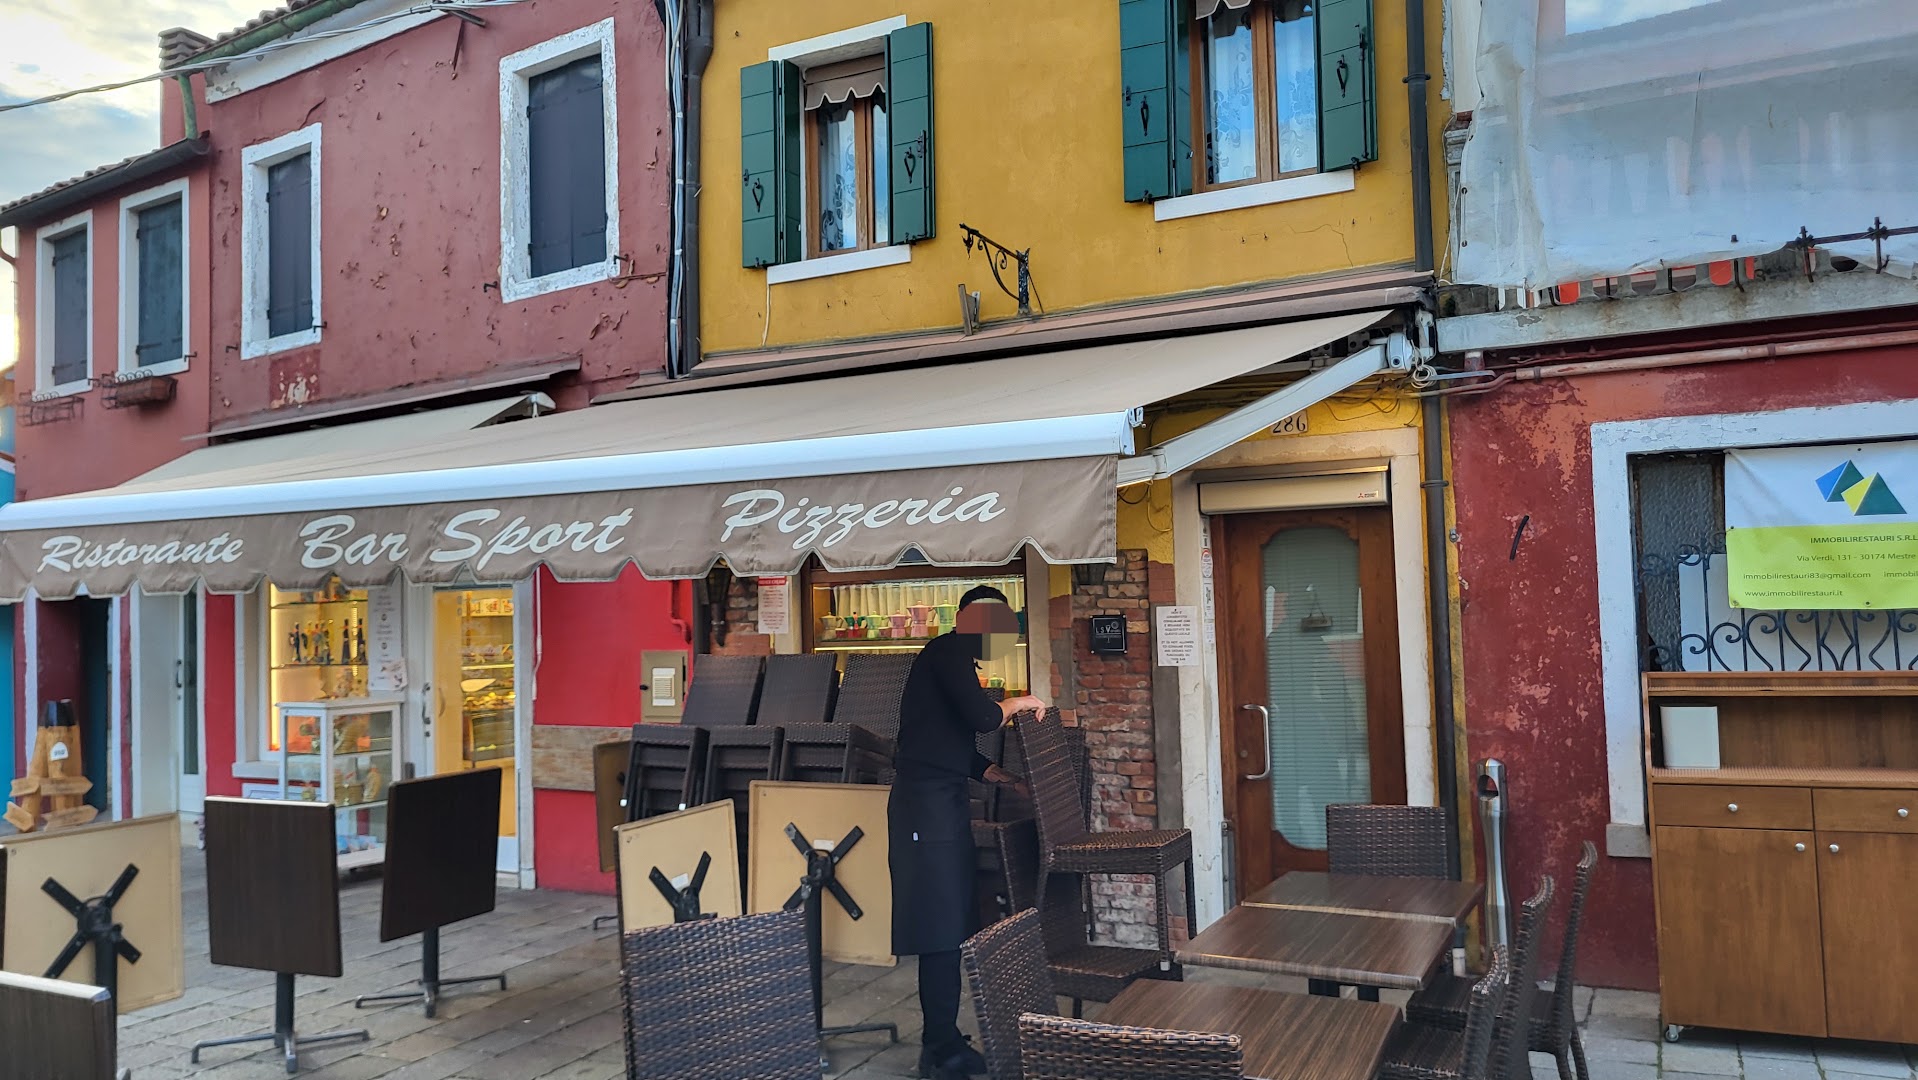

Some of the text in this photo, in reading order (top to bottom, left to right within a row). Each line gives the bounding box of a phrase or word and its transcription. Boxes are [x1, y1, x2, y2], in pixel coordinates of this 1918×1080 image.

[1273, 414, 1306, 434] 286
[37, 486, 1006, 573] Ristorante Bar Sport Pizzeria
[1810, 535, 1895, 543] IMMOBILIRESTAURI
[1811, 554, 1835, 562] Verdi,
[1743, 571, 1871, 580] immobilirestauri83@gmail.com
[1744, 589, 1843, 597] www.immobilirestauri.it
